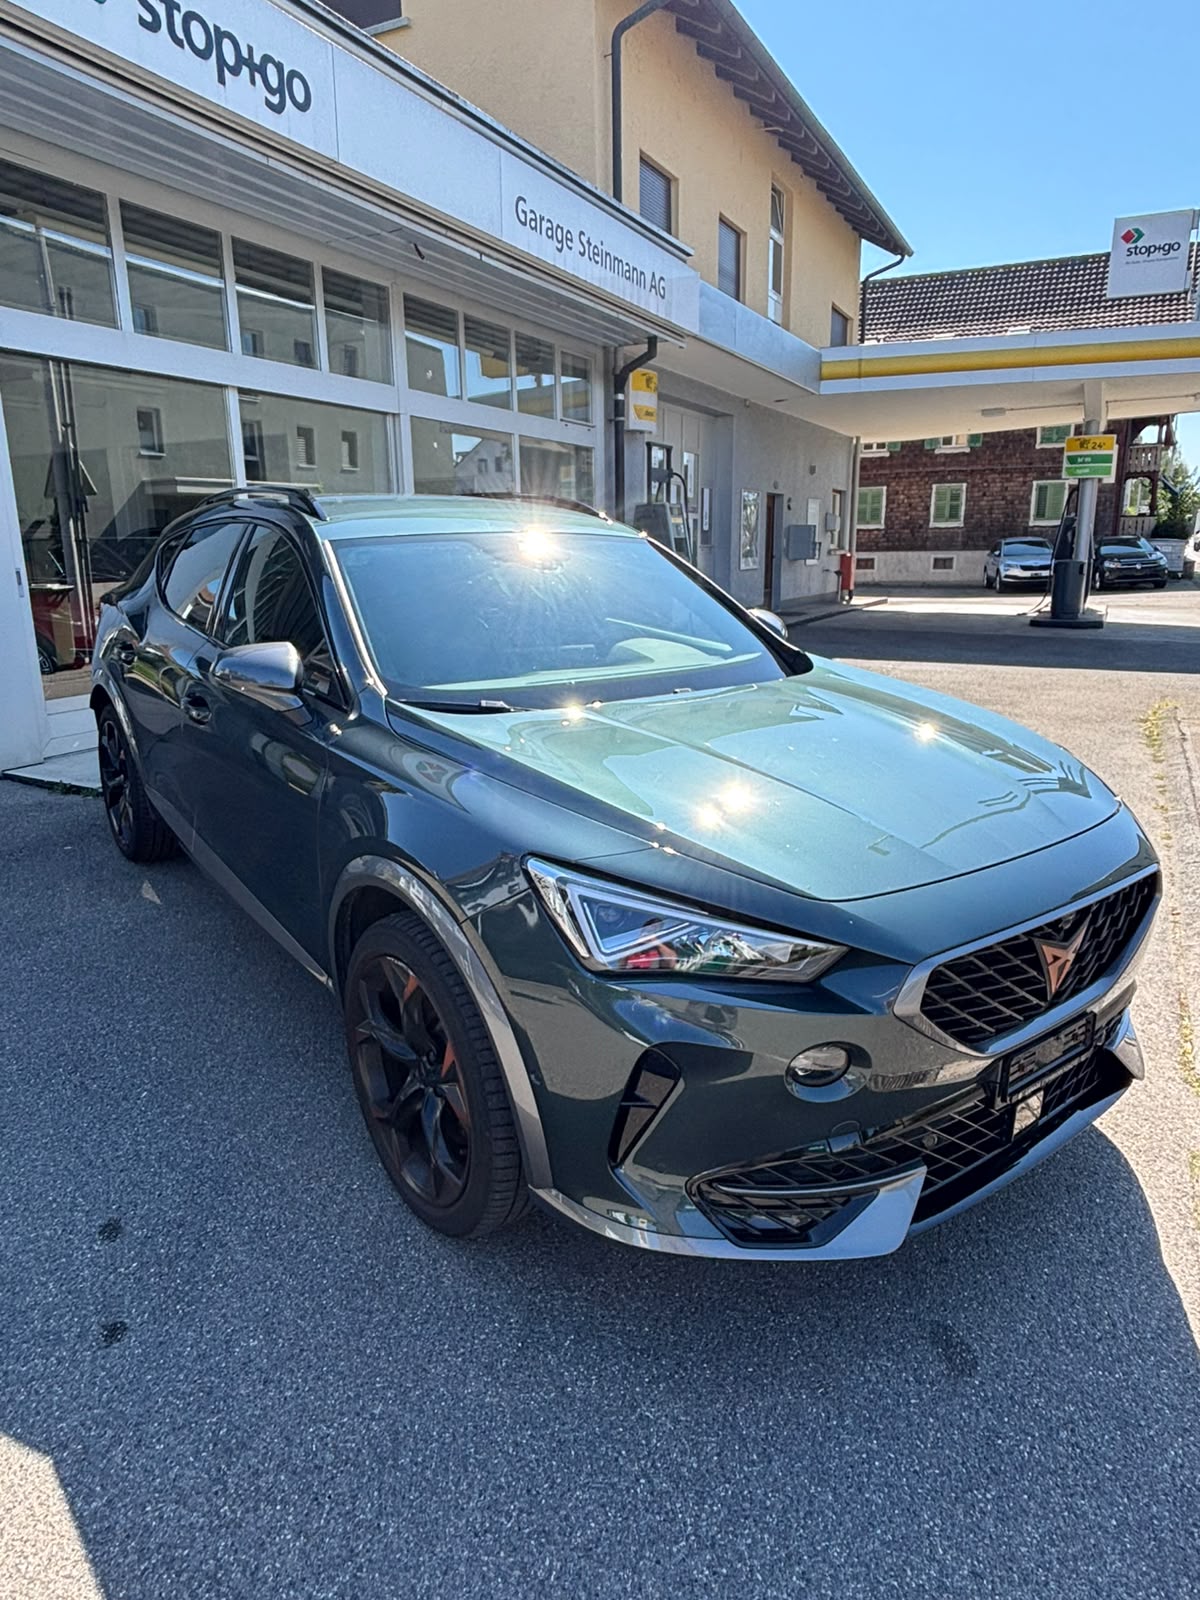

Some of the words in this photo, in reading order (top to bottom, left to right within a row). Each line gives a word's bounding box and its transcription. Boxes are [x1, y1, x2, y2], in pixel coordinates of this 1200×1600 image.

[138, 0, 312, 114] stop+go
[515, 196, 574, 253] Garage
[578, 230, 647, 290] Steinmann
[649, 271, 666, 300] AG
[1126, 241, 1181, 257] stop+go
